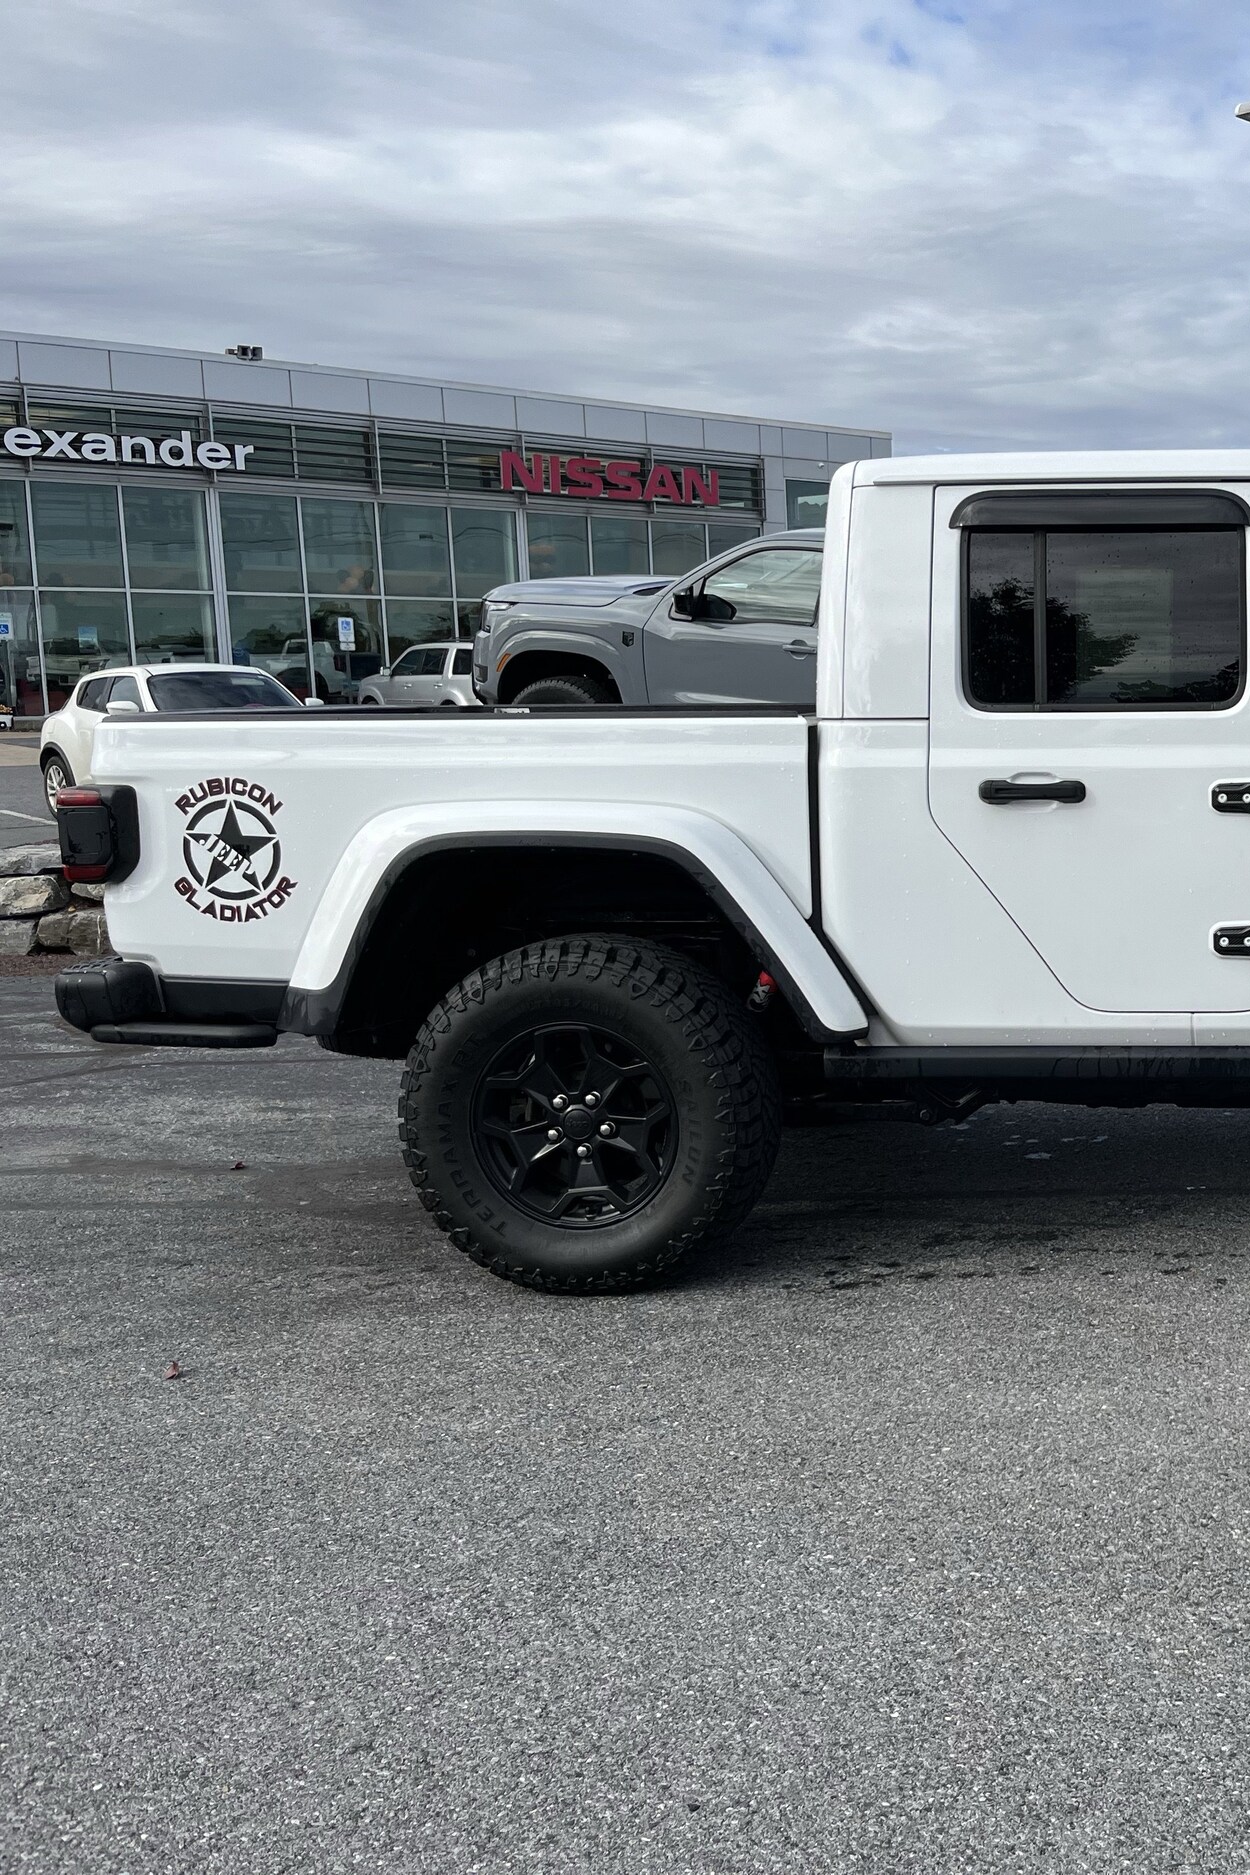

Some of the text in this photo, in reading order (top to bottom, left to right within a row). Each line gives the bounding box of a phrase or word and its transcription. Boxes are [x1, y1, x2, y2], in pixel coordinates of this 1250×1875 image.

[3, 426, 254, 471] exander
[500, 450, 720, 507] NISSAN
[174, 777, 284, 816] RUBICON
[199, 834, 256, 875] JEEP
[174, 876, 298, 923] GLADIATOR
